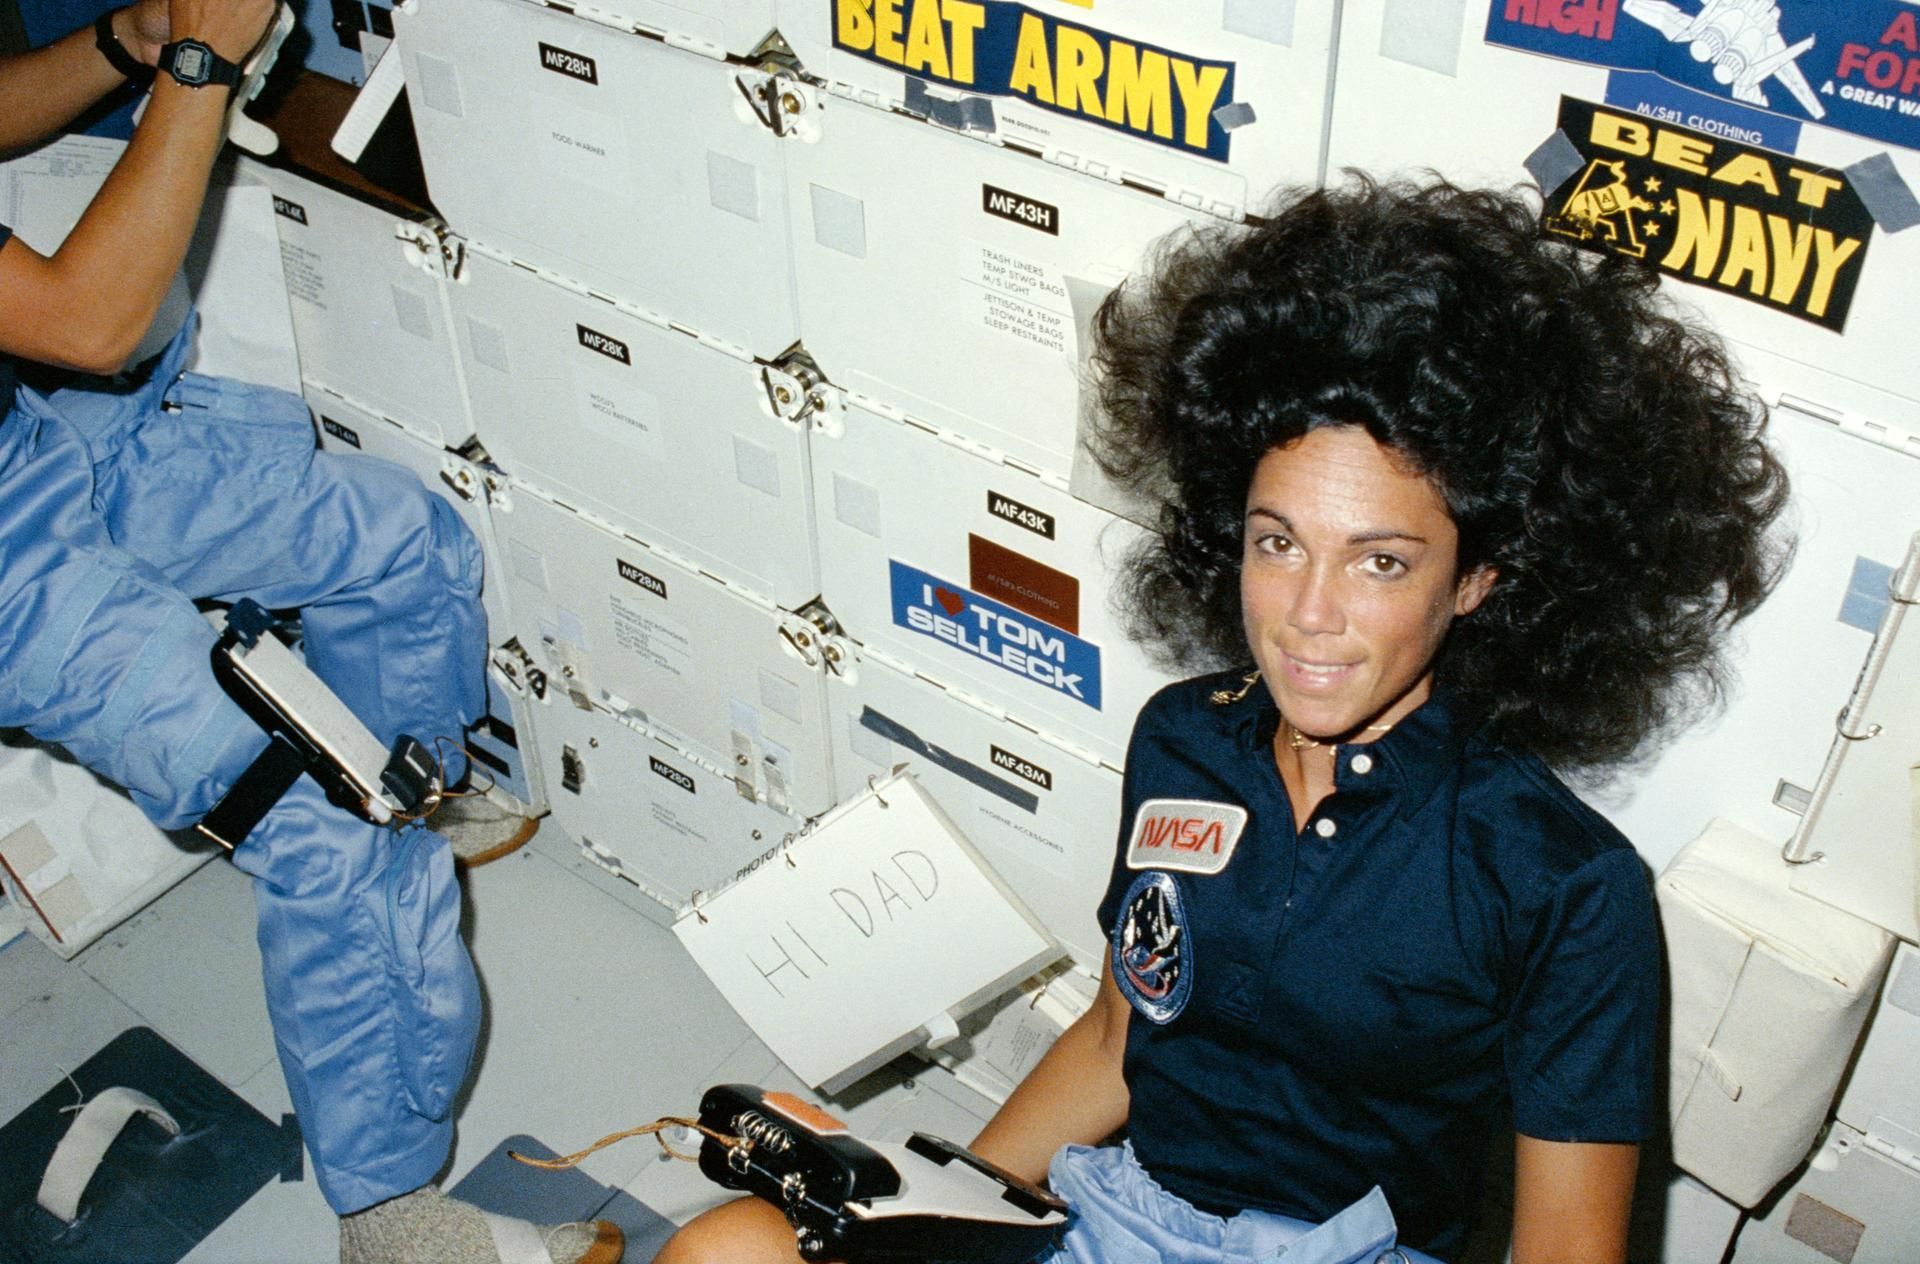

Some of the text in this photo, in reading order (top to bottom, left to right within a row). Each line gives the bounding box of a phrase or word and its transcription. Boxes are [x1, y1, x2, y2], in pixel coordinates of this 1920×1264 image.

[1880, 11, 1920, 52] A
[545, 49, 592, 78] MF28H
[837, 0, 1228, 149] BEAT ARMY
[1820, 80, 1835, 96] A
[1840, 84, 1896, 110] GREAT
[1636, 101, 1764, 145] M/S#1 CLOTHING
[1590, 111, 1842, 209] BEAT
[989, 192, 1051, 228] MF43H
[982, 248, 1044, 278] TRASH LINERS
[1660, 187, 1861, 318] NAVY
[982, 260, 1066, 298] TEMP STWG BAGS
[982, 274, 1030, 296] M/S LIGHT
[984, 293, 1025, 313] JETTISON
[1037, 311, 1061, 326] TEMP
[989, 306, 1064, 341] STOWAGE BAGS
[583, 331, 625, 360] MF28K
[984, 316, 1064, 353] SLEEP RESTRAINTS
[994, 499, 1047, 533] MF43K
[621, 565, 664, 595] MF28M
[1017, 585, 1061, 610] CLOTHING
[923, 583, 1066, 663] I TOM
[907, 605, 1084, 698] SELLECK
[994, 751, 1047, 786] MF43M
[1013, 823, 1064, 854] ACCESSORIES
[1138, 815, 1225, 855] NASA
[746, 850, 939, 998] HI DAD
